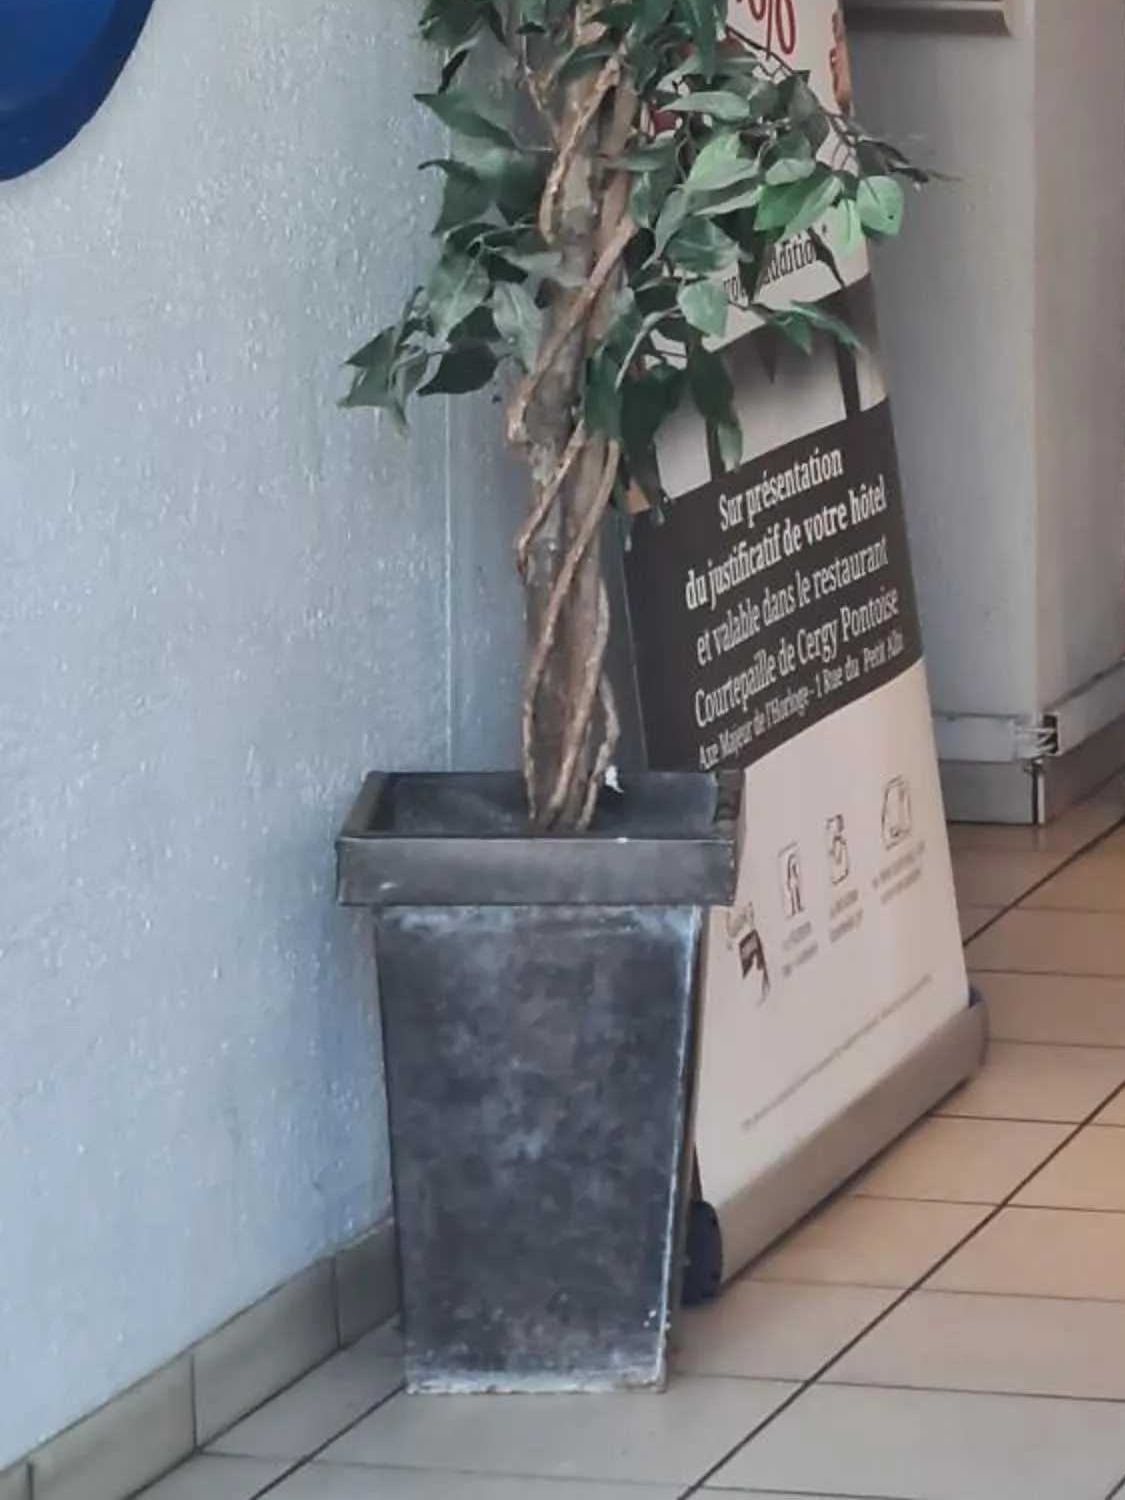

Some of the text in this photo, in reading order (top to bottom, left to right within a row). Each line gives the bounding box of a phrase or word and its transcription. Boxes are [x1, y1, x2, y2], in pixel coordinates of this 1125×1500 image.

[685, 473, 888, 611] du justificatif de votre hôtel
[719, 447, 843, 531] Sur présentation
[695, 586, 899, 728] Courtepaille de Cergy Pontoise
[697, 534, 889, 667] et valable dans le restaurant
